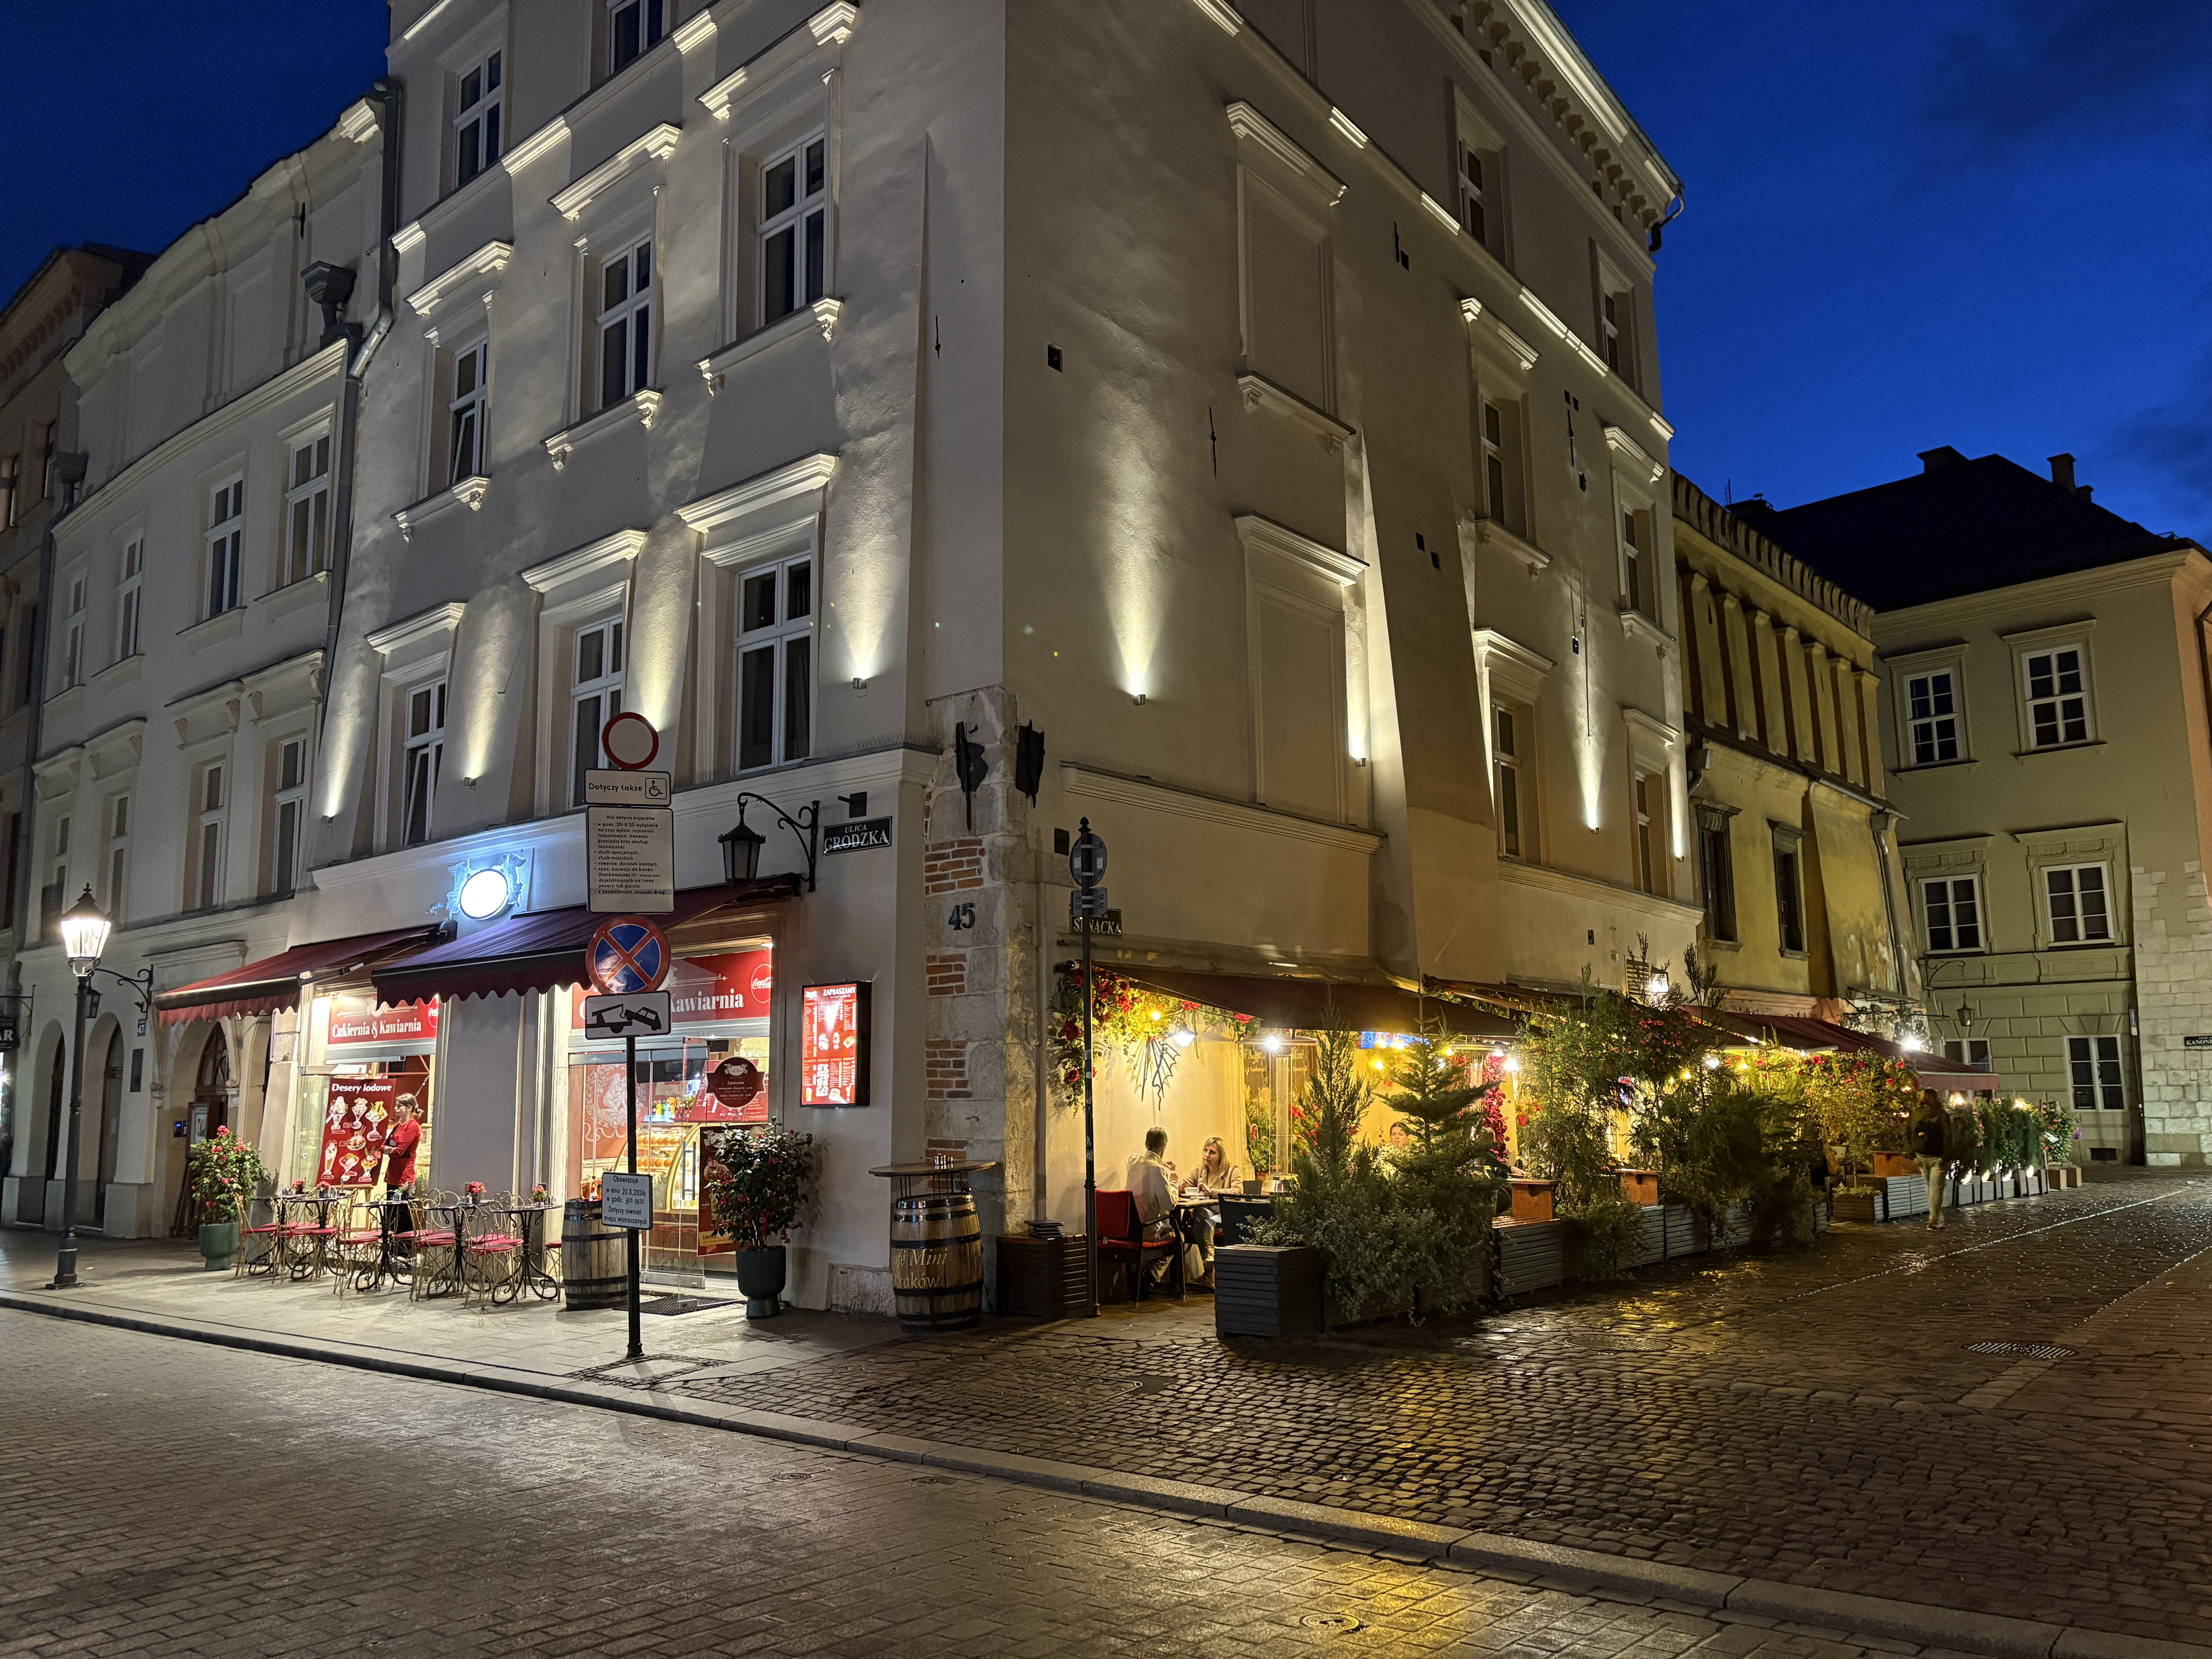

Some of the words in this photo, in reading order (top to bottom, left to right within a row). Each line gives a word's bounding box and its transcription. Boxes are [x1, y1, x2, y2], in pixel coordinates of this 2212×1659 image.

[589, 783, 619, 792] Dotyczy
[844, 824, 867, 833] ULICA
[824, 830, 889, 851] GRODZKA
[948, 902, 975, 931] 45
[1073, 918, 1121, 935] SNACKA
[823, 987, 856, 996] ZAPRASZAMY
[138, 1025, 144, 1034] 47
[332, 1021, 370, 1038] Cukiernia
[371, 1021, 378, 1039] &
[379, 1017, 422, 1034] Kawiarnia
[332, 1083, 362, 1094] Desery
[363, 1083, 392, 1092] lodowe
[608, 1206, 624, 1215] Dotyczy
[618, 1218, 648, 1227] wyznaczonych
[909, 1248, 947, 1266] Mini
[899, 1271, 940, 1289] raków
